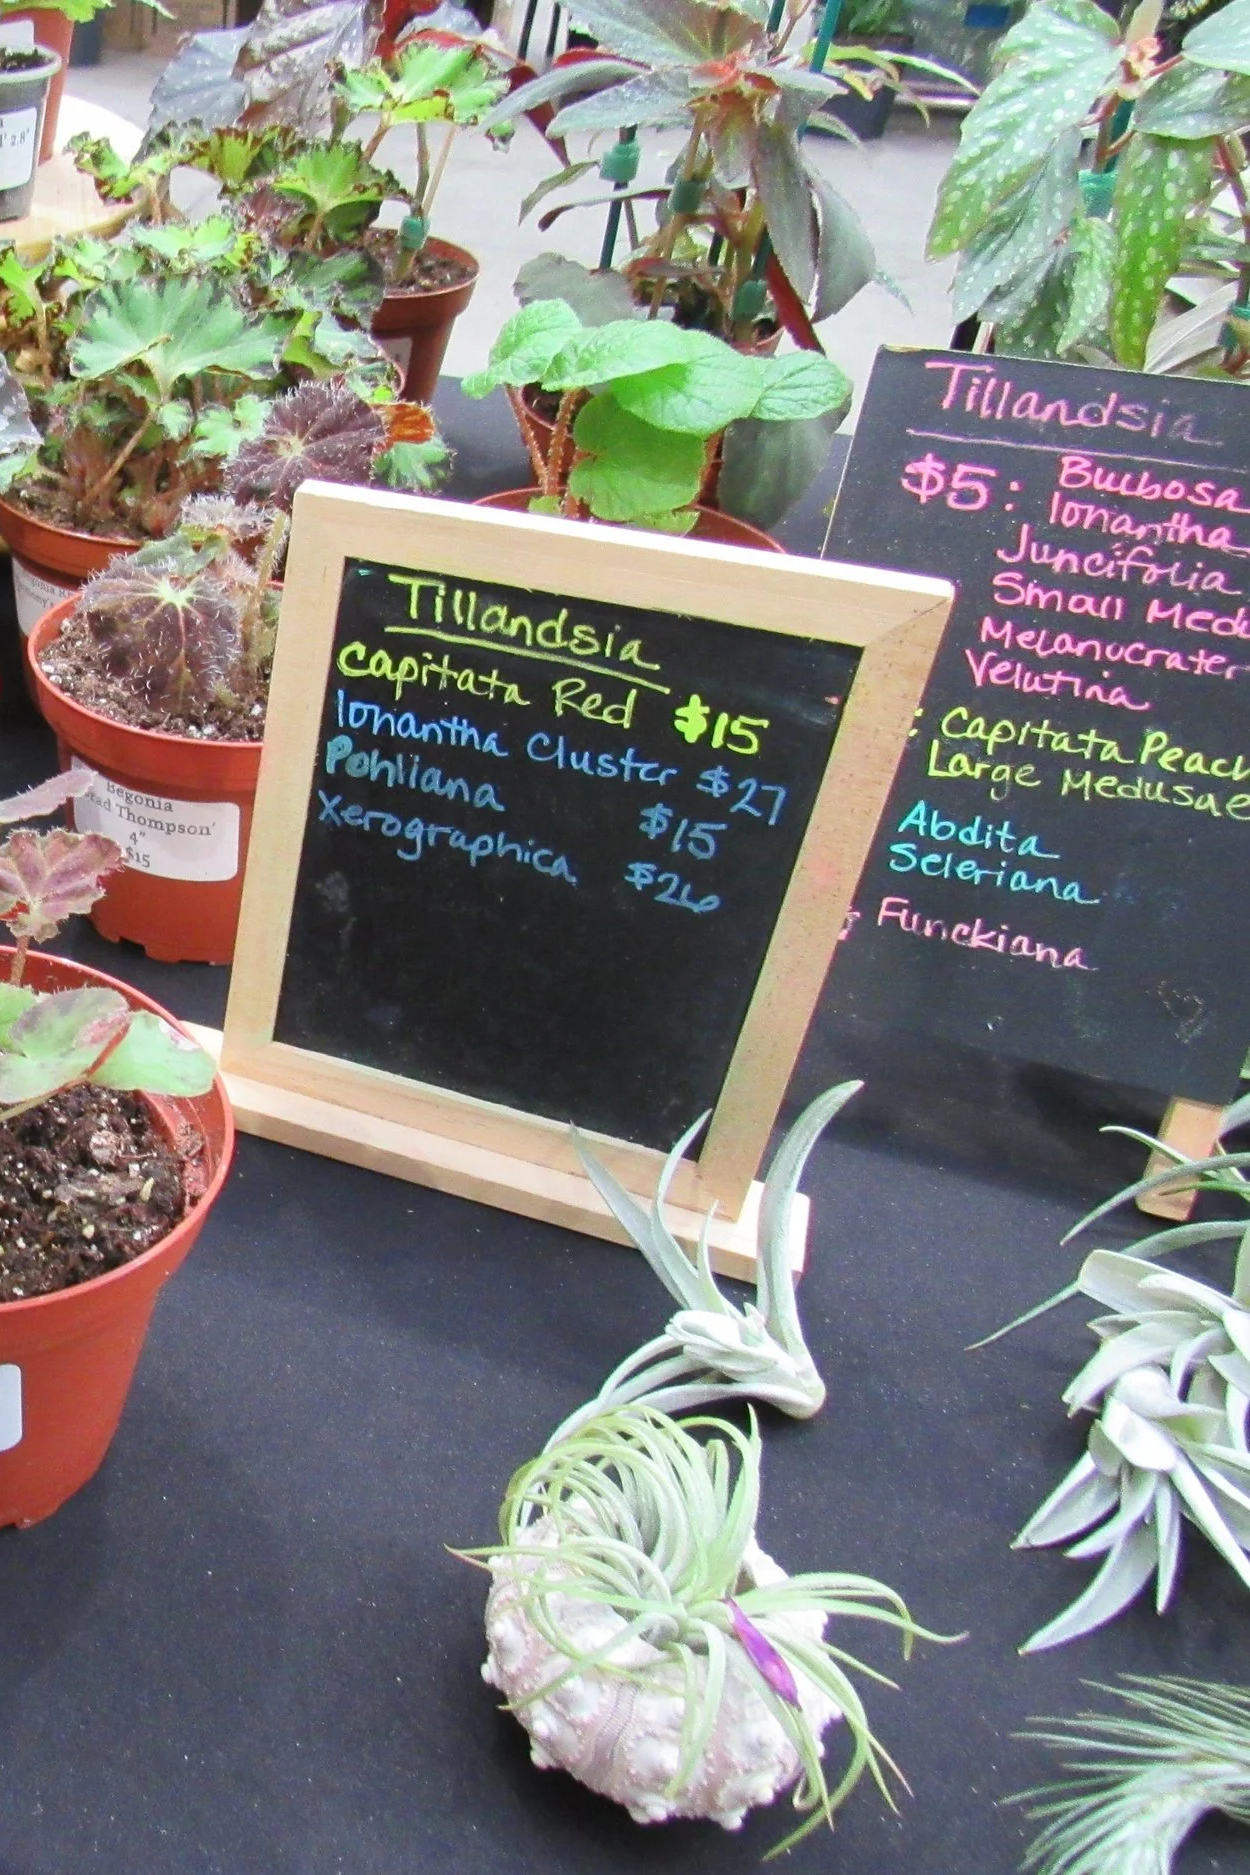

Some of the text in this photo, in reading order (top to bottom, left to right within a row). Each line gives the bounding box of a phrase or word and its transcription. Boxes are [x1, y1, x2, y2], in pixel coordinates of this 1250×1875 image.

[924, 361, 1225, 448] Tillandsia
[387, 573, 661, 671] Tillandsia
[992, 571, 1123, 621] Small
[337, 640, 769, 756] Capitata Red $15
[965, 648, 1151, 712] Velutina
[940, 706, 1134, 765] Capitata
[106, 780, 174, 813] Begonia
[326, 734, 729, 861] Pohliana $15
[526, 732, 678, 786] Cluster
[695, 765, 788, 827] $27
[927, 739, 1041, 801] Large
[115, 804, 216, 836] Thompson'
[129, 831, 146, 845] 4"
[897, 799, 1060, 859] Abdita
[125, 846, 150, 869] $15
[624, 861, 722, 914] $26
[888, 842, 1101, 905] Seleriana
[877, 896, 1100, 971] Funckiana
